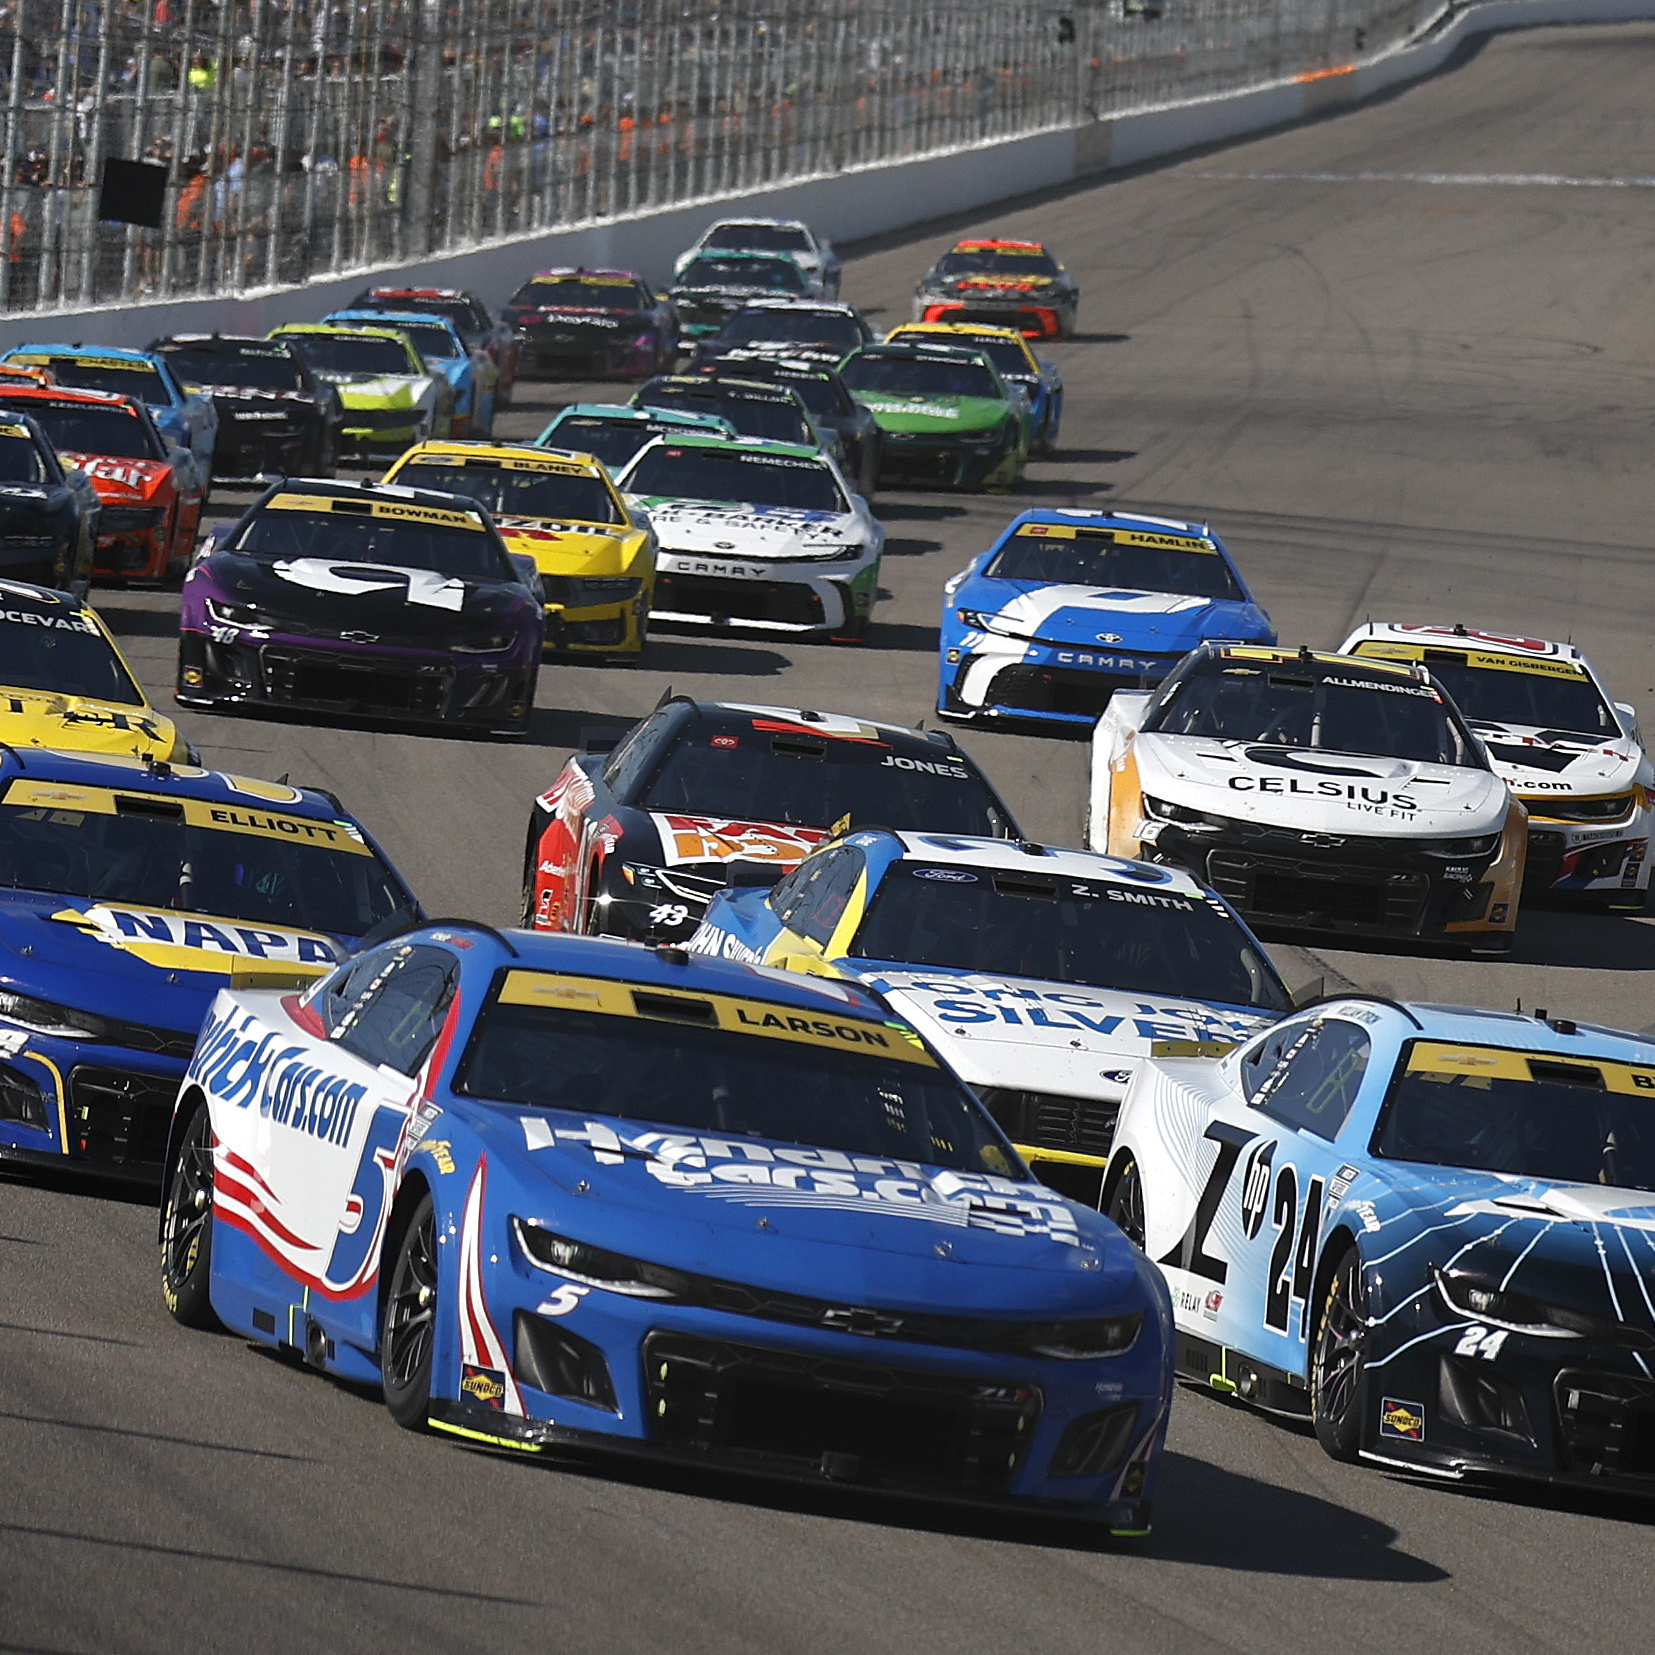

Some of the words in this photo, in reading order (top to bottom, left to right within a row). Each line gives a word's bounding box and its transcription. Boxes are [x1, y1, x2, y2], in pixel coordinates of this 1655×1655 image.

[514, 460, 583, 474] BLANEY
[378, 505, 467, 524] BOWMAN
[1130, 533, 1208, 551] HAMLIN
[678, 561, 767, 577] CAMRY
[1057, 651, 1158, 670] CAMRY
[1476, 655, 1506, 666] VAN
[880, 753, 968, 780] JONES
[1228, 775, 1419, 811] CELSIUS
[1346, 801, 1384, 817] LIVE
[1391, 810, 1417, 823] FIT
[210, 809, 338, 843] ELLIOTT
[1072, 884, 1099, 898] Z.
[1108, 888, 1195, 913] SMITH
[649, 903, 689, 926] 43
[108, 906, 338, 967] NAPA
[736, 1007, 889, 1048] LARSON
[1263, 1162, 1327, 1343] 24
[536, 1282, 591, 1317] 5
[1179, 1291, 1202, 1314] RELAY
[1454, 1325, 1511, 1361] 24
[462, 1379, 505, 1398] SUNOCO
[1382, 1412, 1422, 1429] SUNOCO
